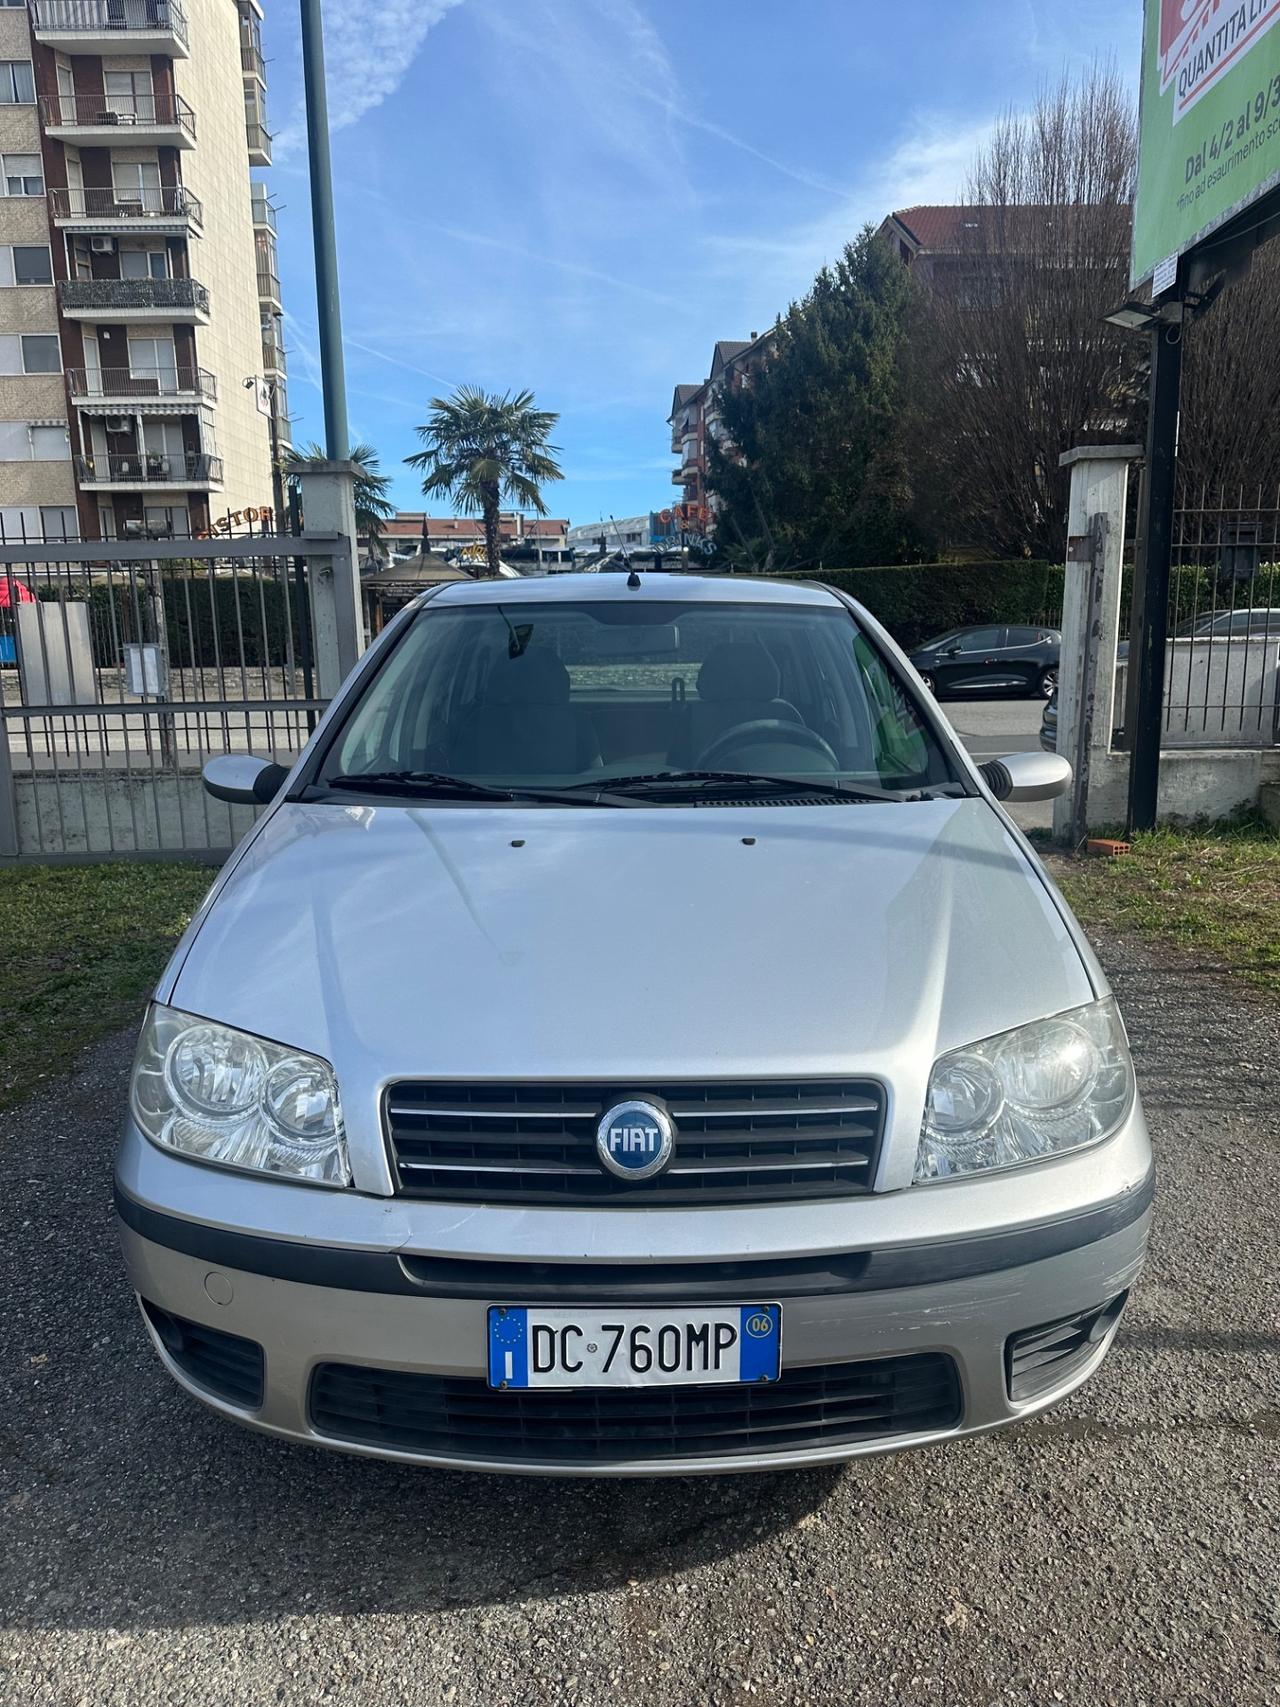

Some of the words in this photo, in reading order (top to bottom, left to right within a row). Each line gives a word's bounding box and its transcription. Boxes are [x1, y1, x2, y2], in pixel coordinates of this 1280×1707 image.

[1185, 141, 1207, 184] Dal
[1209, 119, 1234, 160] 4/2
[1236, 100, 1251, 139] al
[1195, 181, 1206, 201] ad
[1207, 130, 1266, 189] esaurimento
[654, 533, 717, 555] DRINKS
[609, 1127, 659, 1152] FIAT
[752, 1320, 769, 1332] 06
[532, 1324, 584, 1373] DC
[601, 1322, 738, 1373] 760MP
